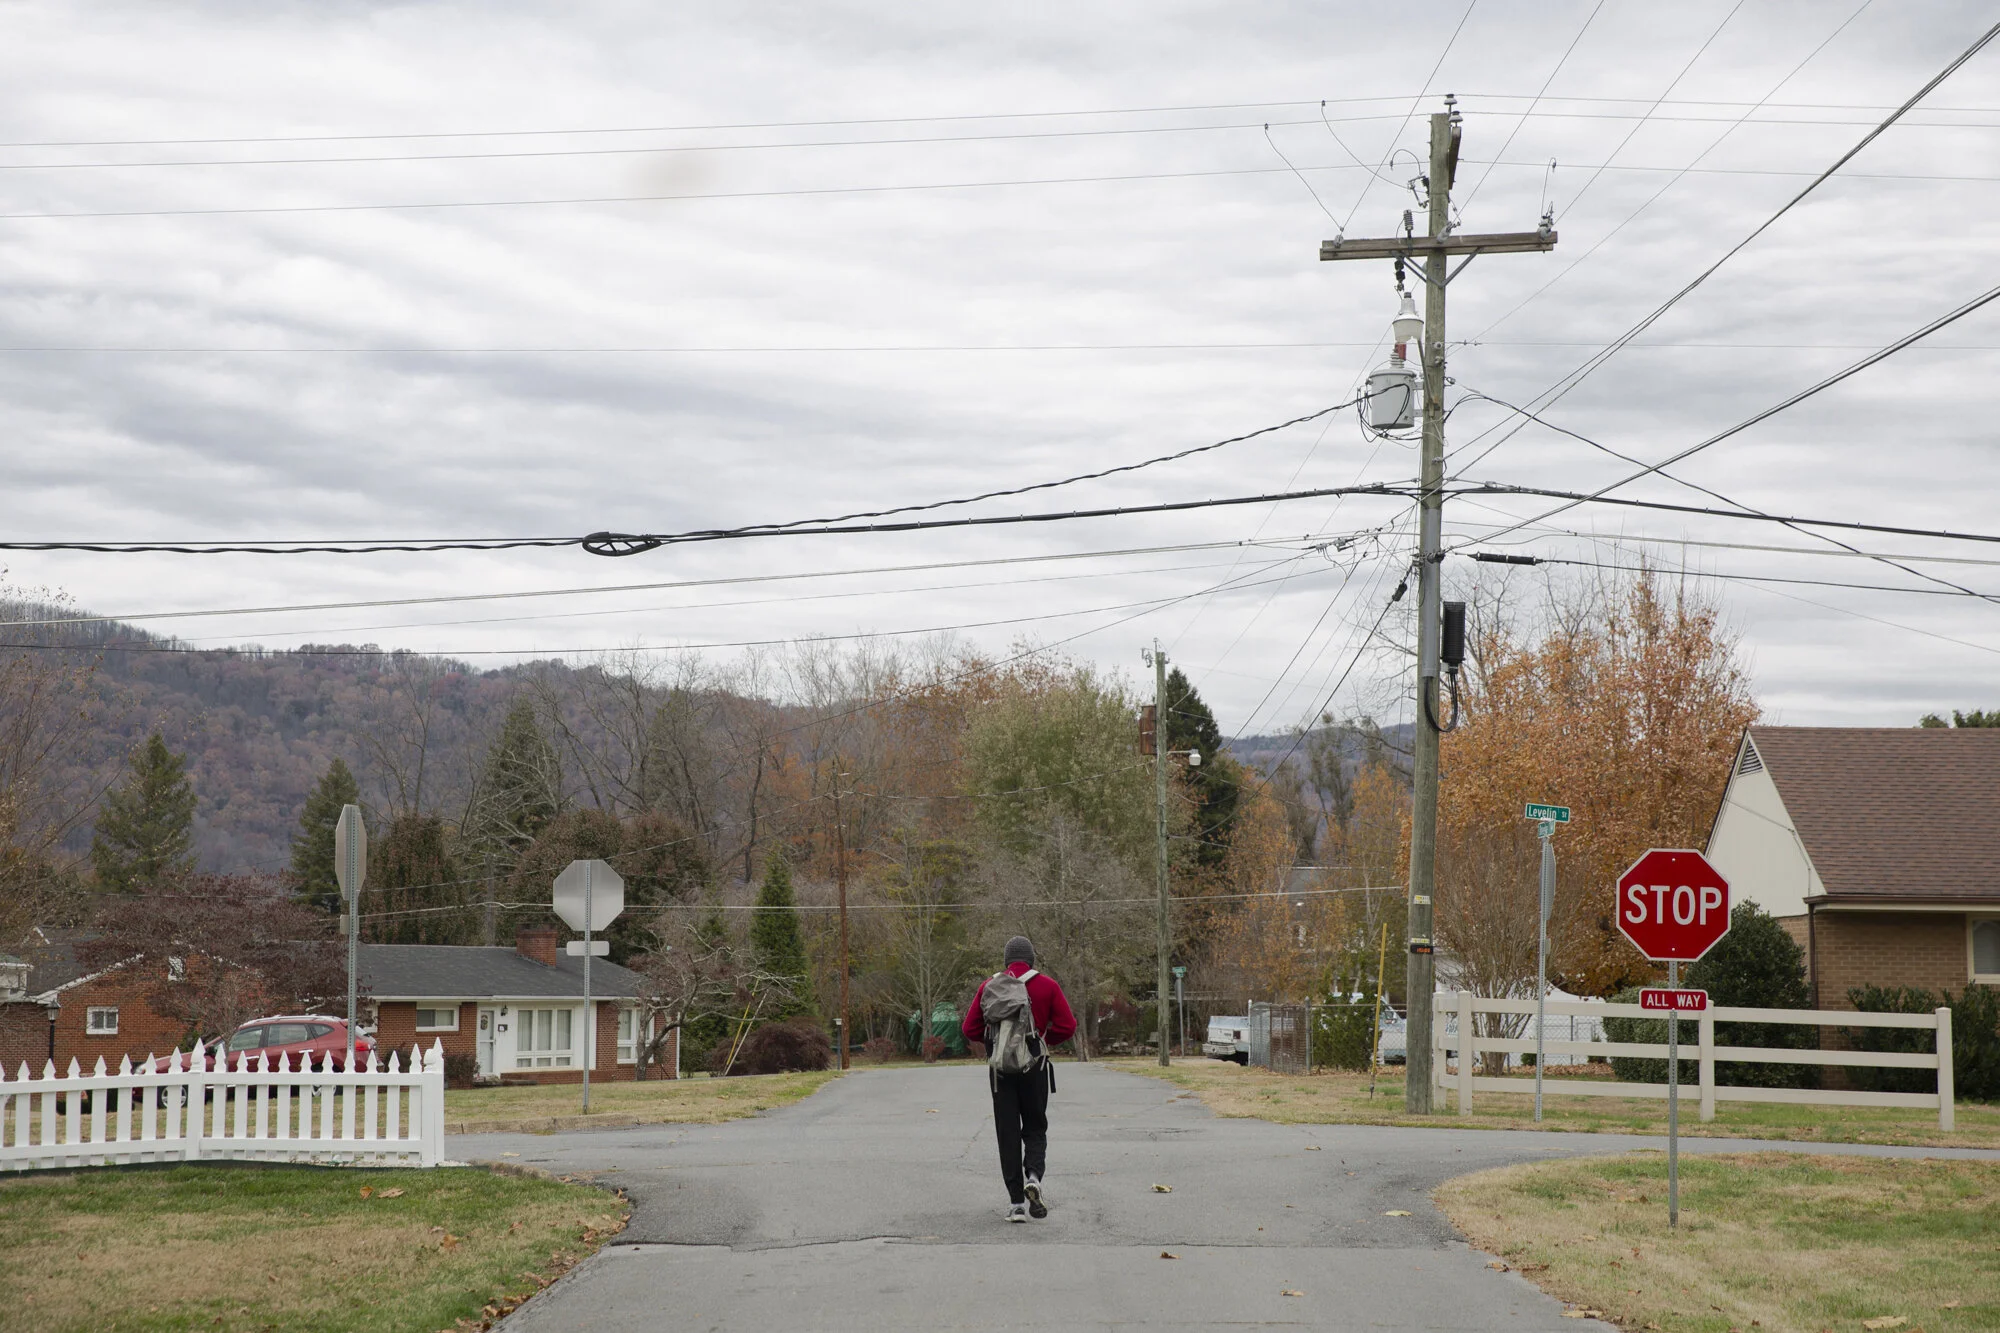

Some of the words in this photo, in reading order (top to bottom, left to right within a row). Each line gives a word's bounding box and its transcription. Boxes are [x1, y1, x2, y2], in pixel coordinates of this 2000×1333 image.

[1625, 884, 1722, 926] STOP
[1646, 993, 1669, 1007] ALL
[1676, 994, 1702, 1008] WAY
